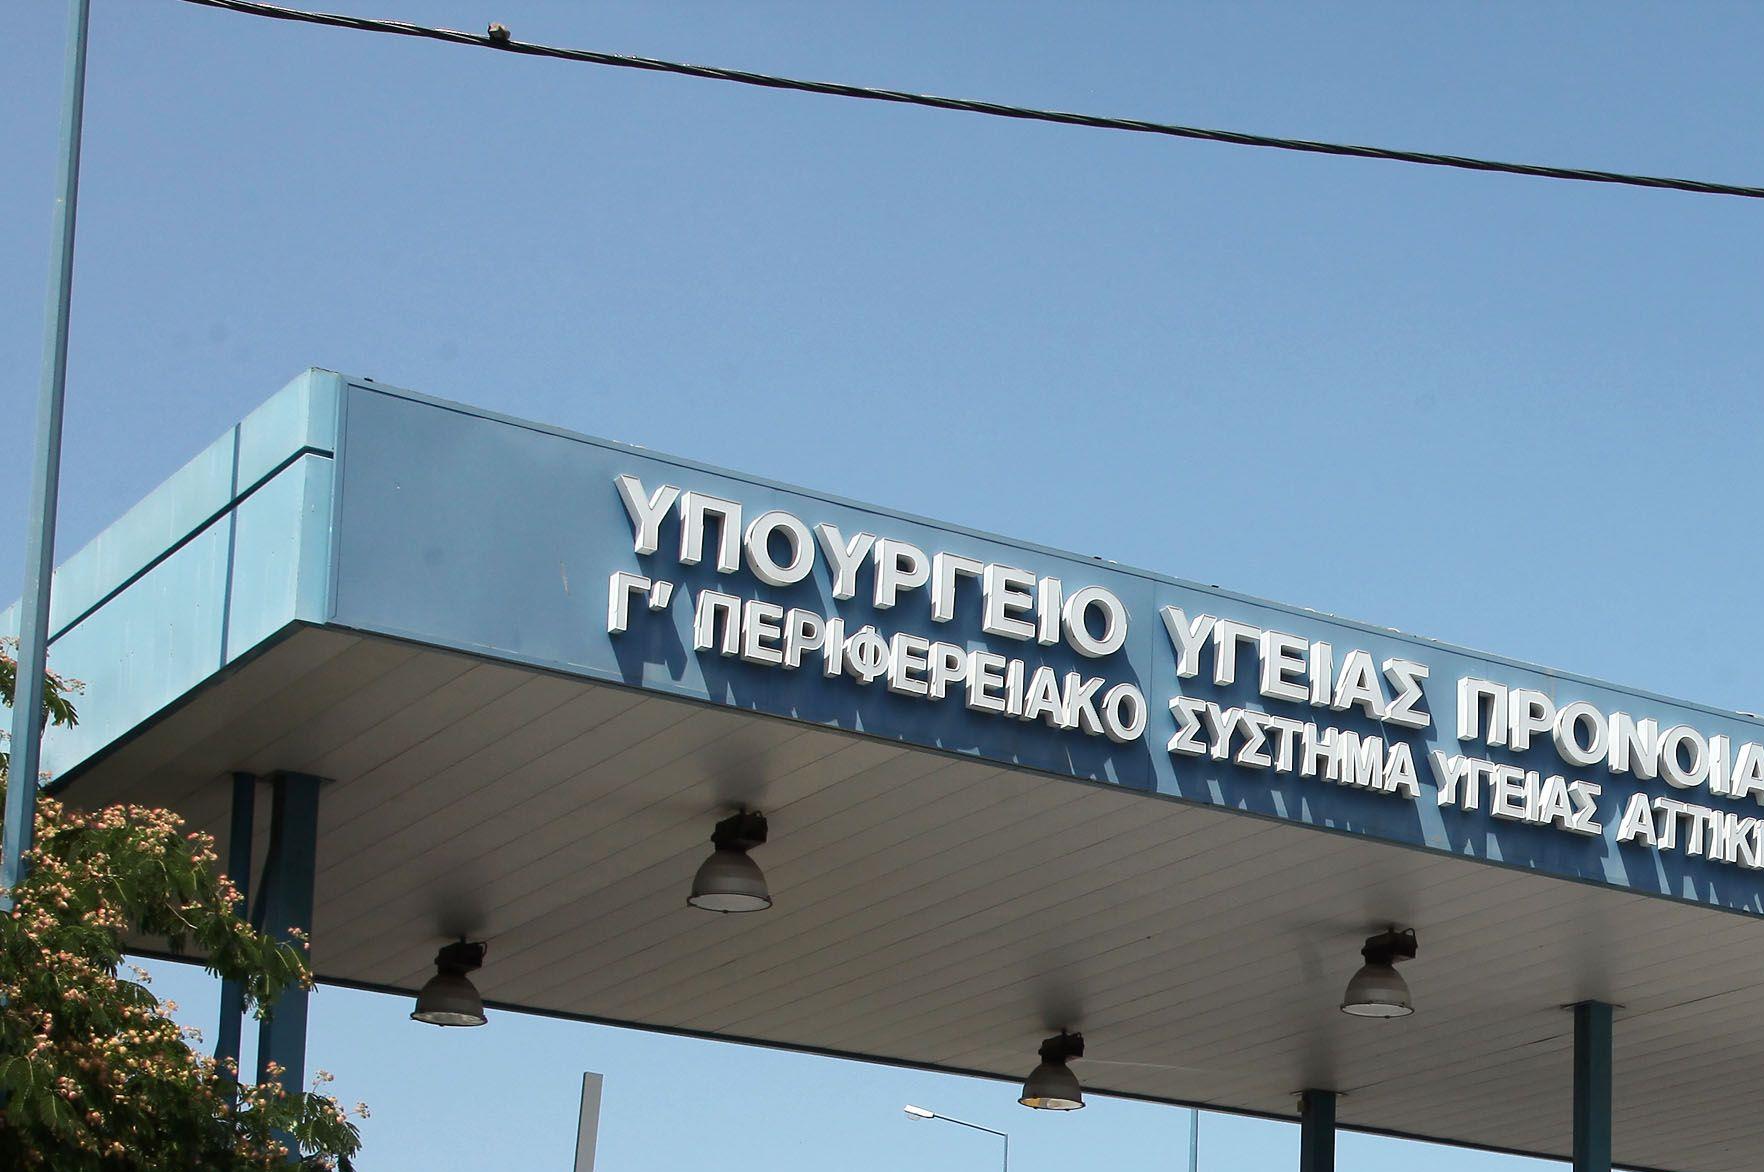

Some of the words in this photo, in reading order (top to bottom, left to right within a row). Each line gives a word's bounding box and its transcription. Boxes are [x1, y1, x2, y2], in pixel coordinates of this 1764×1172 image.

[614, 473, 1128, 658] ΥΠΟΥΡΓΕΙΟ
[1161, 605, 1430, 729] ΥΓΕΙΑΣ
[694, 588, 1147, 743] ΠΕΡΙΦΕΡΕΙΑΚΟ
[1168, 695, 1421, 799] ΣΥΣΤΗΜΑ
[1429, 749, 1602, 836] ΥΓΕΙΑΣ
